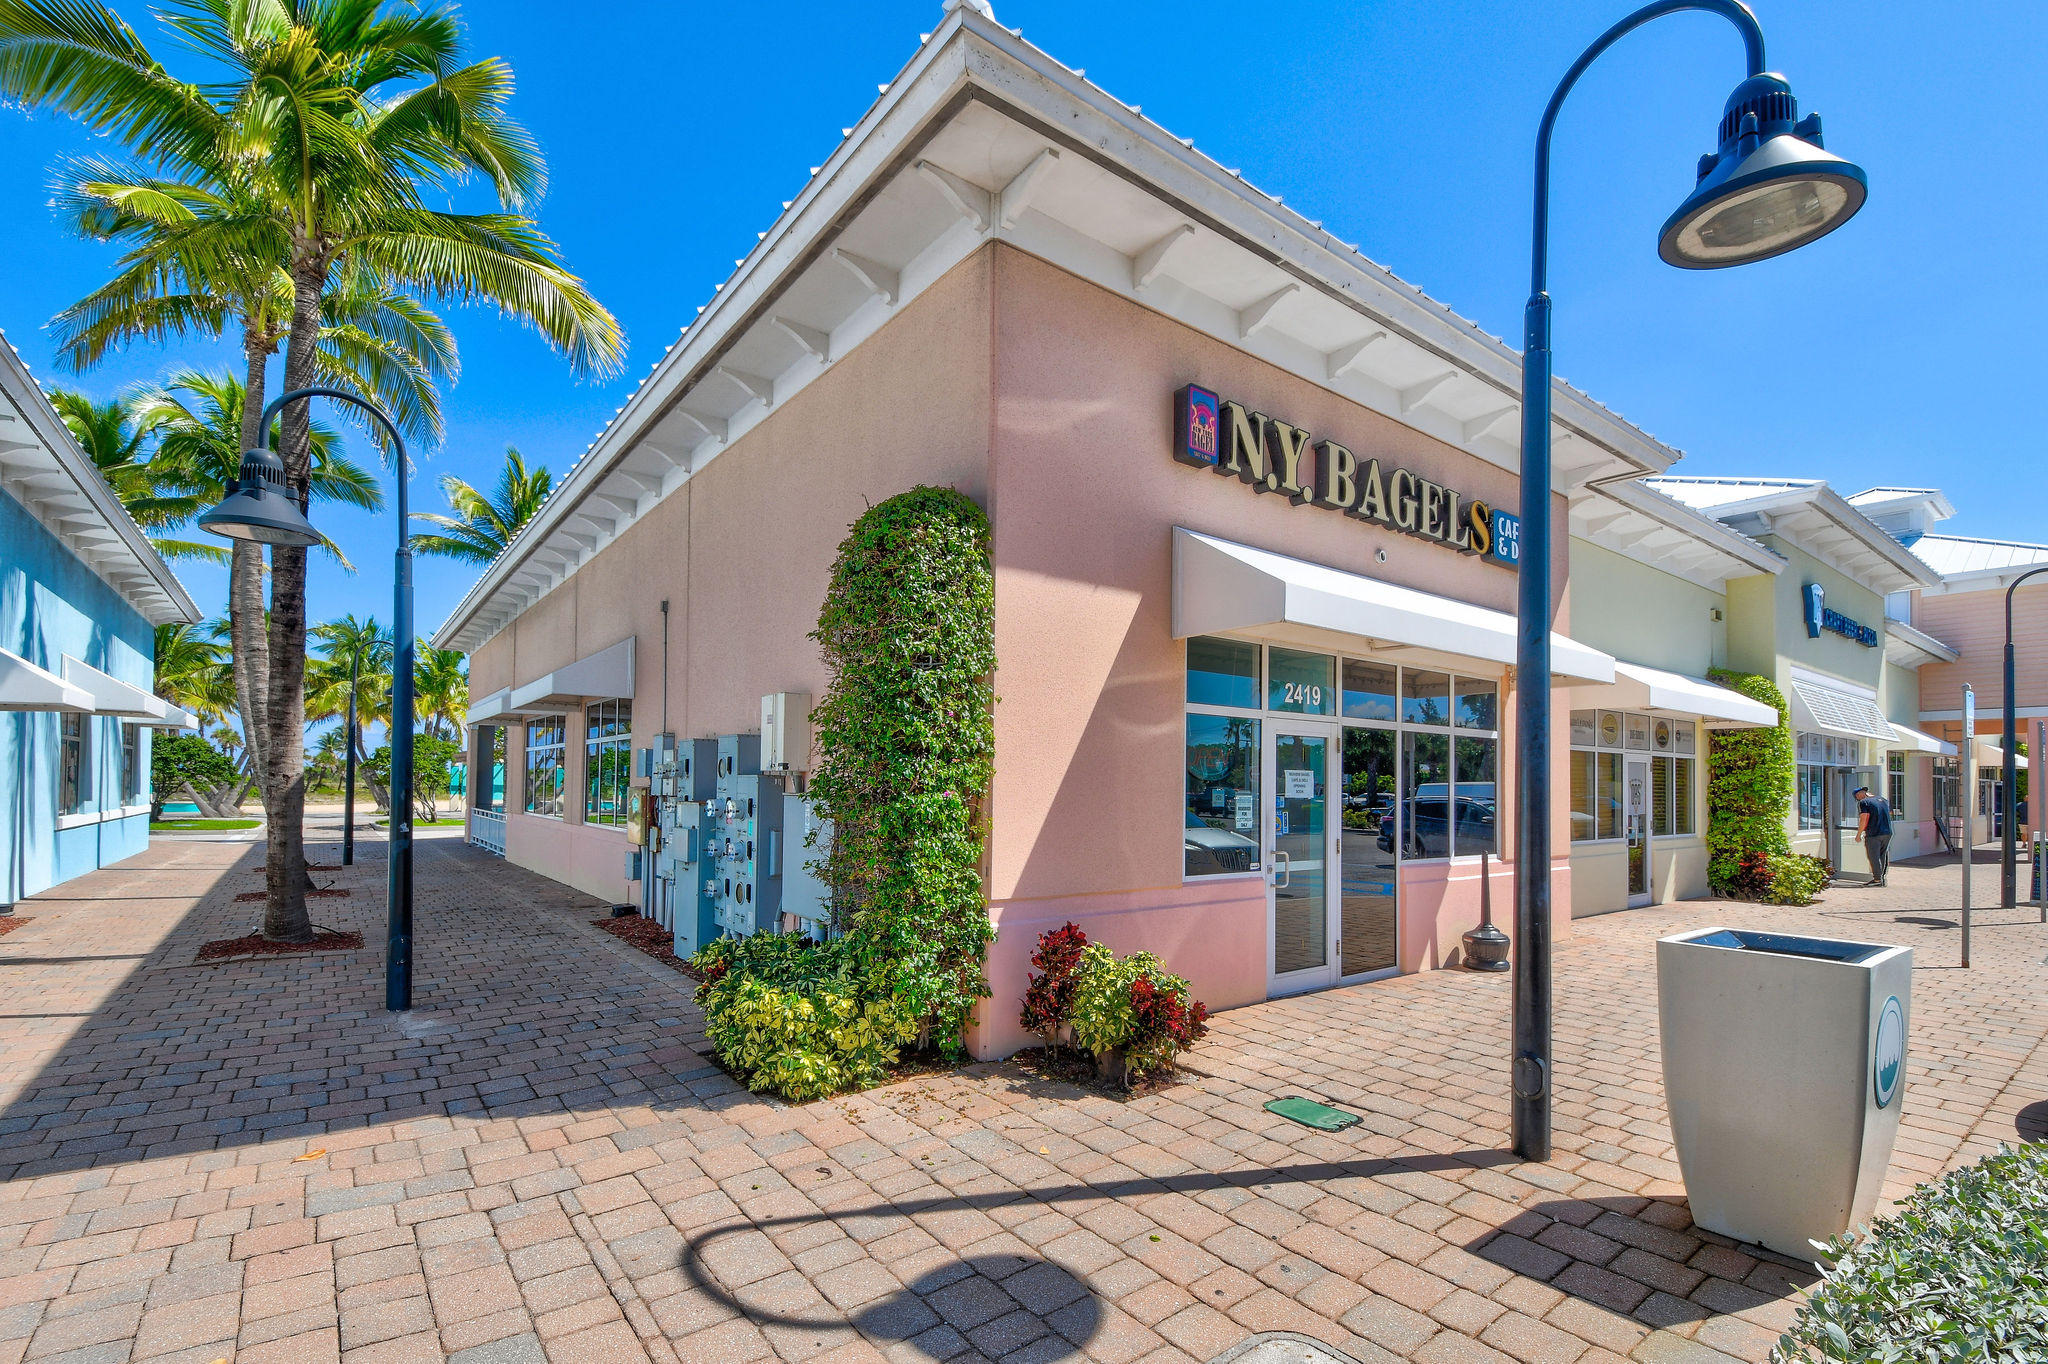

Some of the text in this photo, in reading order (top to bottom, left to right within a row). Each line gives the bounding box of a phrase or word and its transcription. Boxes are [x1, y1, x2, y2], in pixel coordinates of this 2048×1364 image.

[1226, 400, 1490, 556] N.Y. BAGELS
[1498, 517, 1519, 540] CAF
[1284, 682, 1321, 706] 2419
